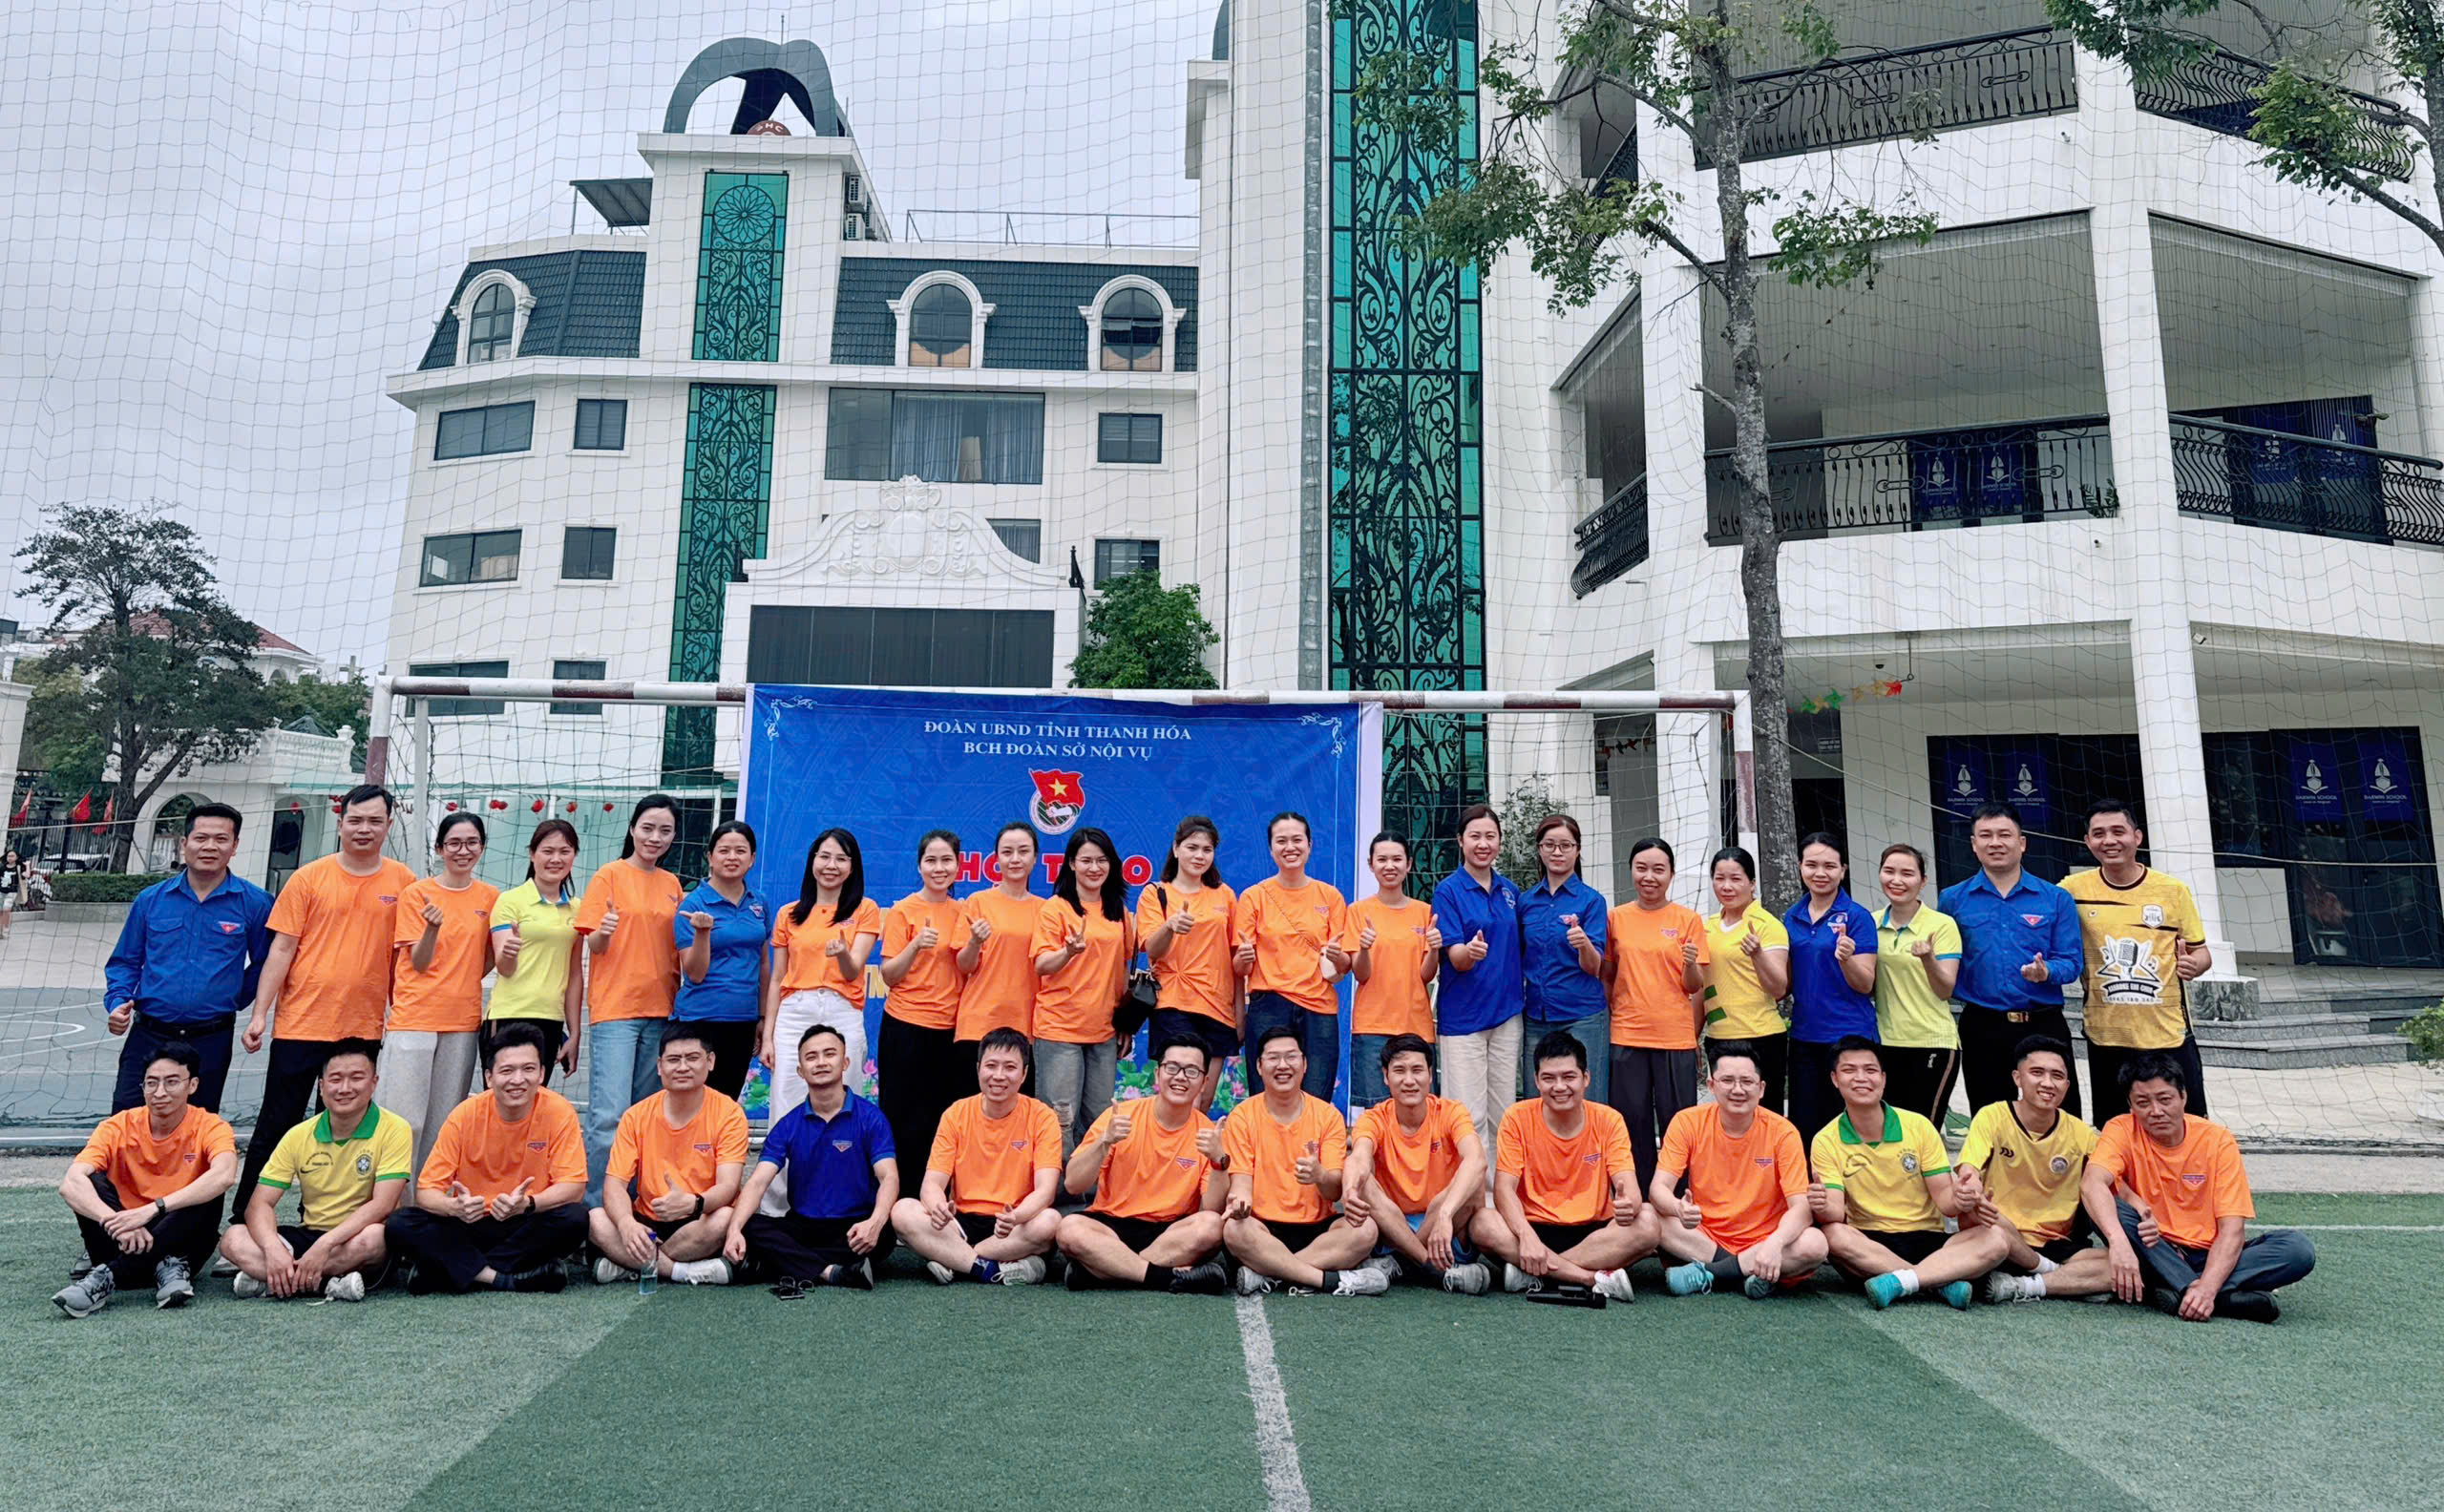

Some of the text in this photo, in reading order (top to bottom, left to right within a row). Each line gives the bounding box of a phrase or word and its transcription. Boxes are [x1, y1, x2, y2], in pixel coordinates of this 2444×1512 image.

[924, 719, 1191, 740] ĐOÀN UBND TỈNH THANH HÓA
[964, 741, 1152, 761] BCH ĐOÀN SỞ NỘI VỤ
[1042, 852, 1153, 887] TO
